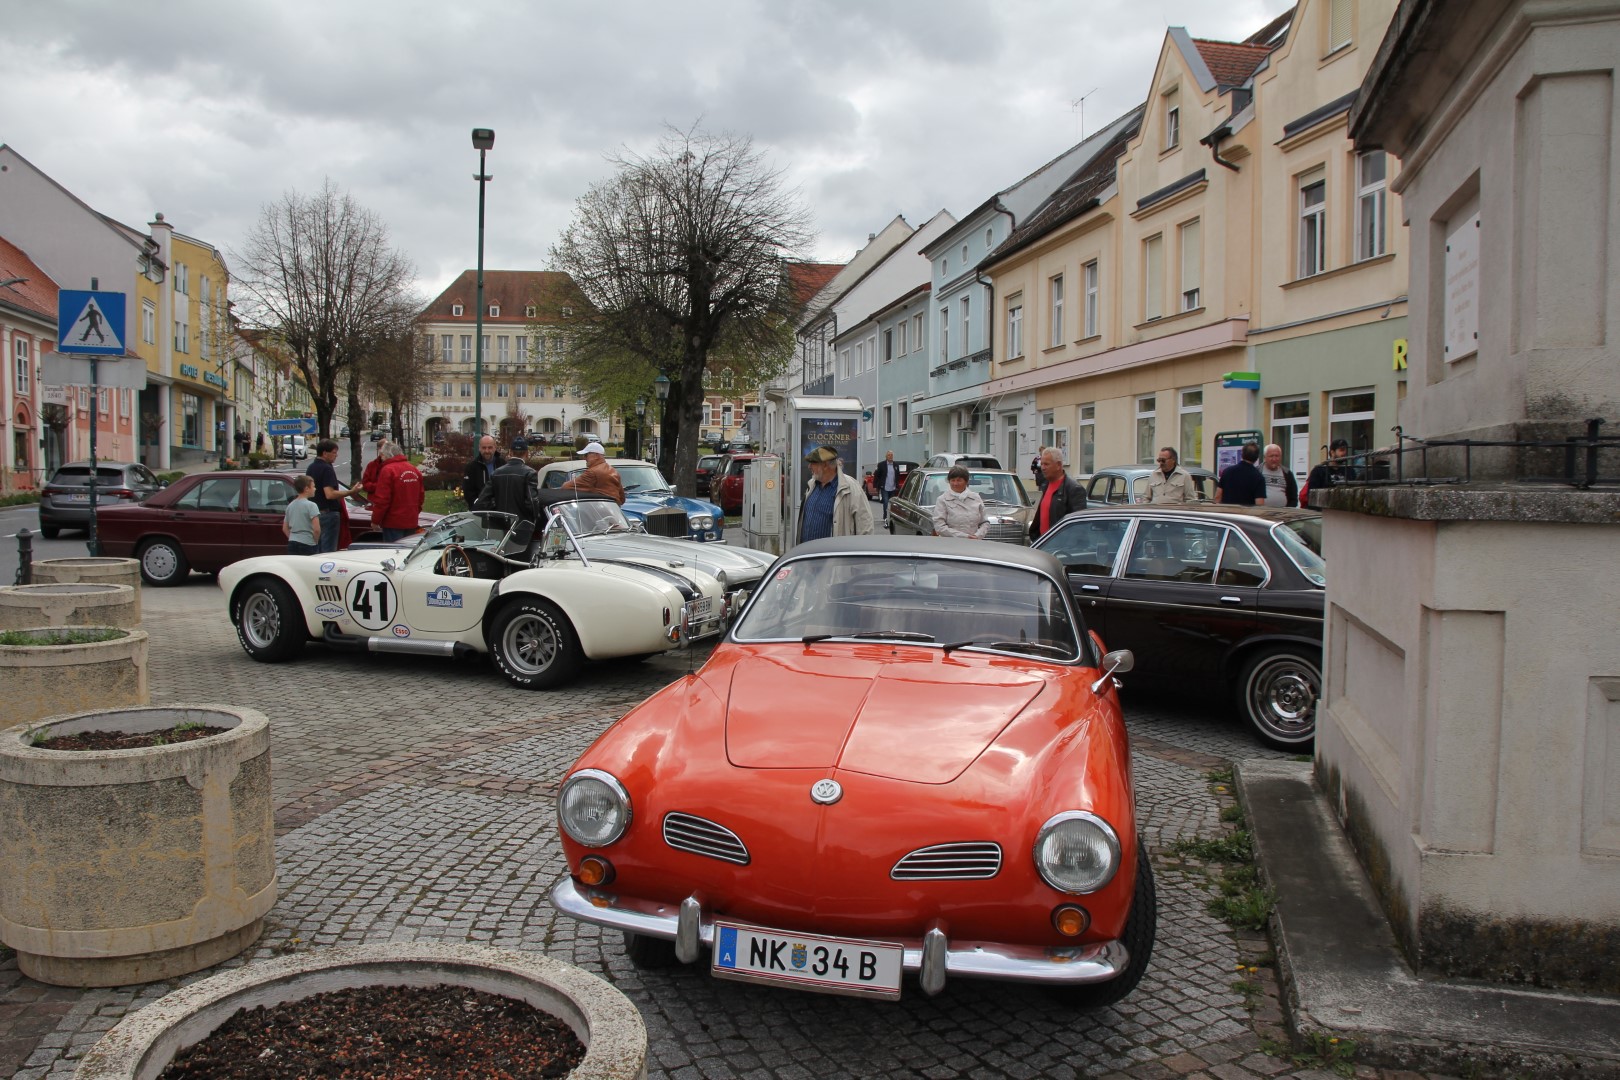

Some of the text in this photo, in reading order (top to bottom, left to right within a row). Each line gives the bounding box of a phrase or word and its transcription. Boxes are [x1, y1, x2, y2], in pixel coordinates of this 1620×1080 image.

[352, 580, 388, 621] 41
[441, 590, 448, 599] 19
[521, 606, 556, 628] RADIAL
[395, 627, 408, 635] Esso
[723, 952, 732, 962] A
[749, 936, 877, 981] NK 34 B
